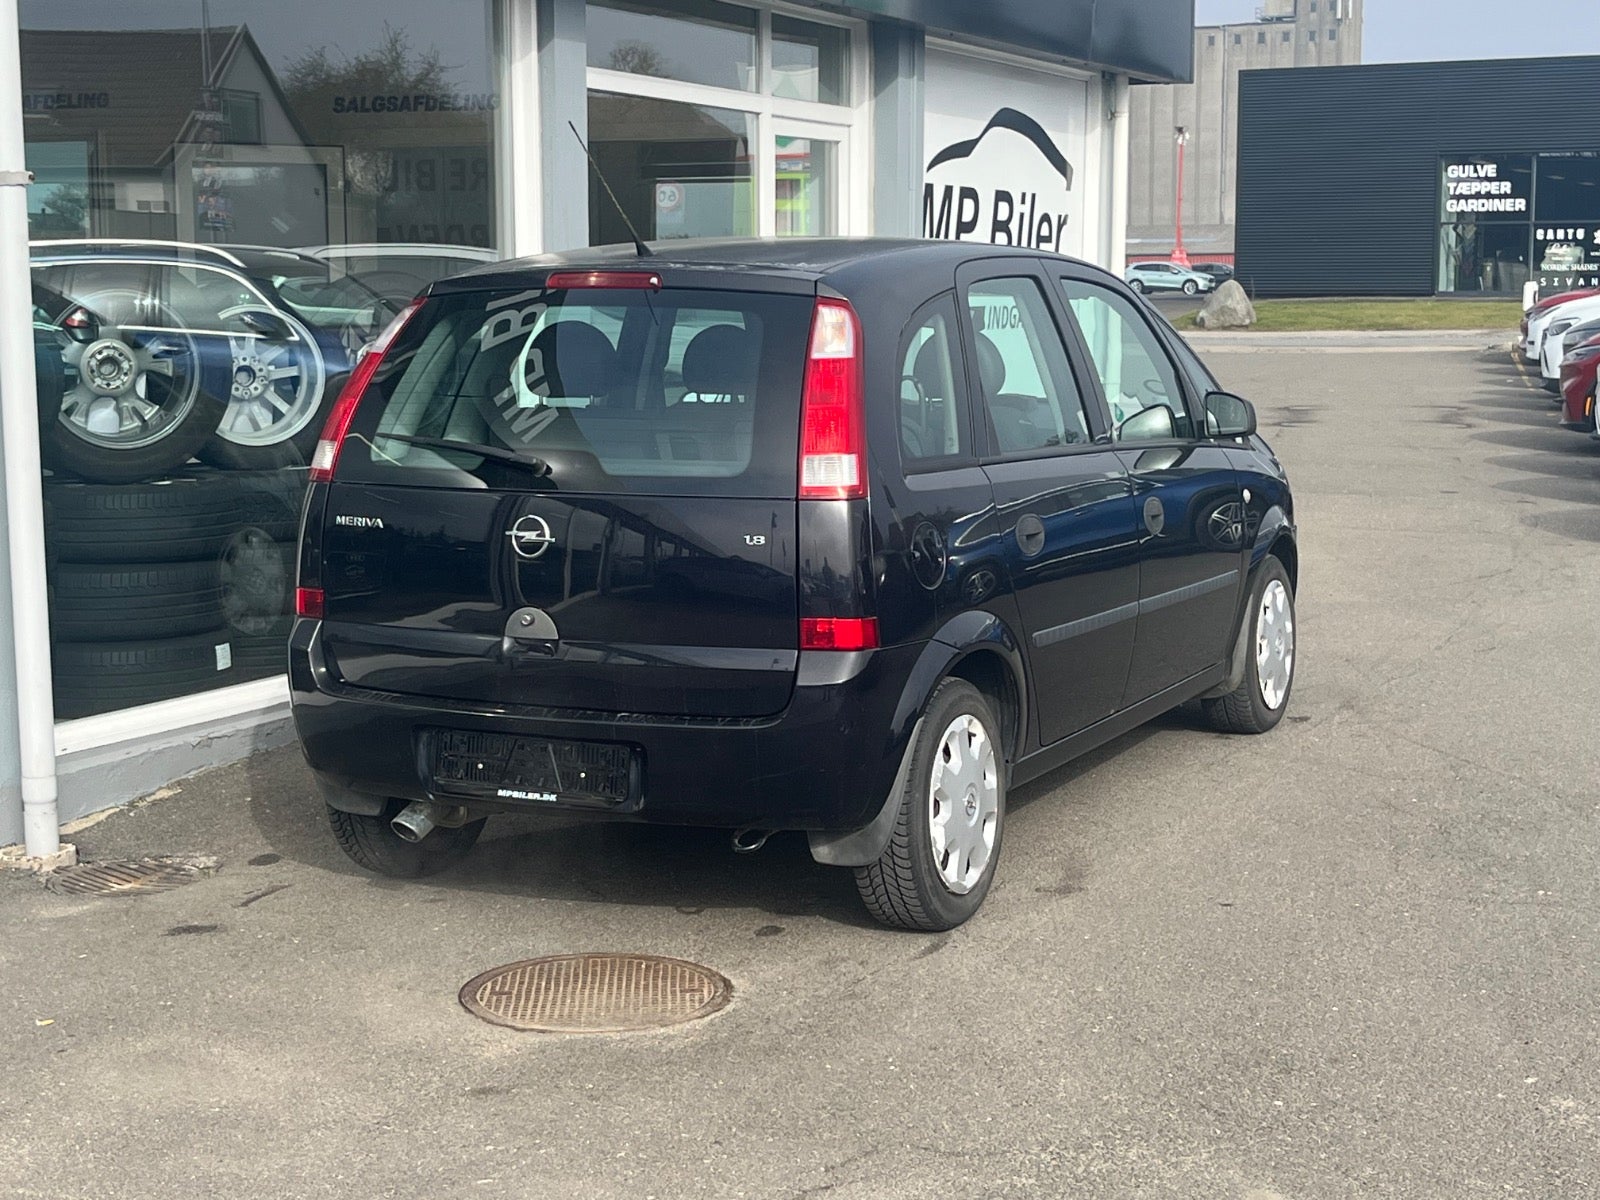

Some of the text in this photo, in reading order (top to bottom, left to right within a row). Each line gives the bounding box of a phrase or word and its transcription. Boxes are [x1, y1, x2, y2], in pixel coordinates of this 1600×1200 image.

[332, 93, 500, 114] SALGSAFDELING
[1447, 164, 1498, 178] GULVE
[1447, 181, 1512, 195] TÆPPER
[1446, 199, 1527, 212] GARDINER
[922, 182, 1069, 253] MP Biler
[335, 515, 384, 529] MERIVA
[497, 789, 558, 802] MPBILER.DK
